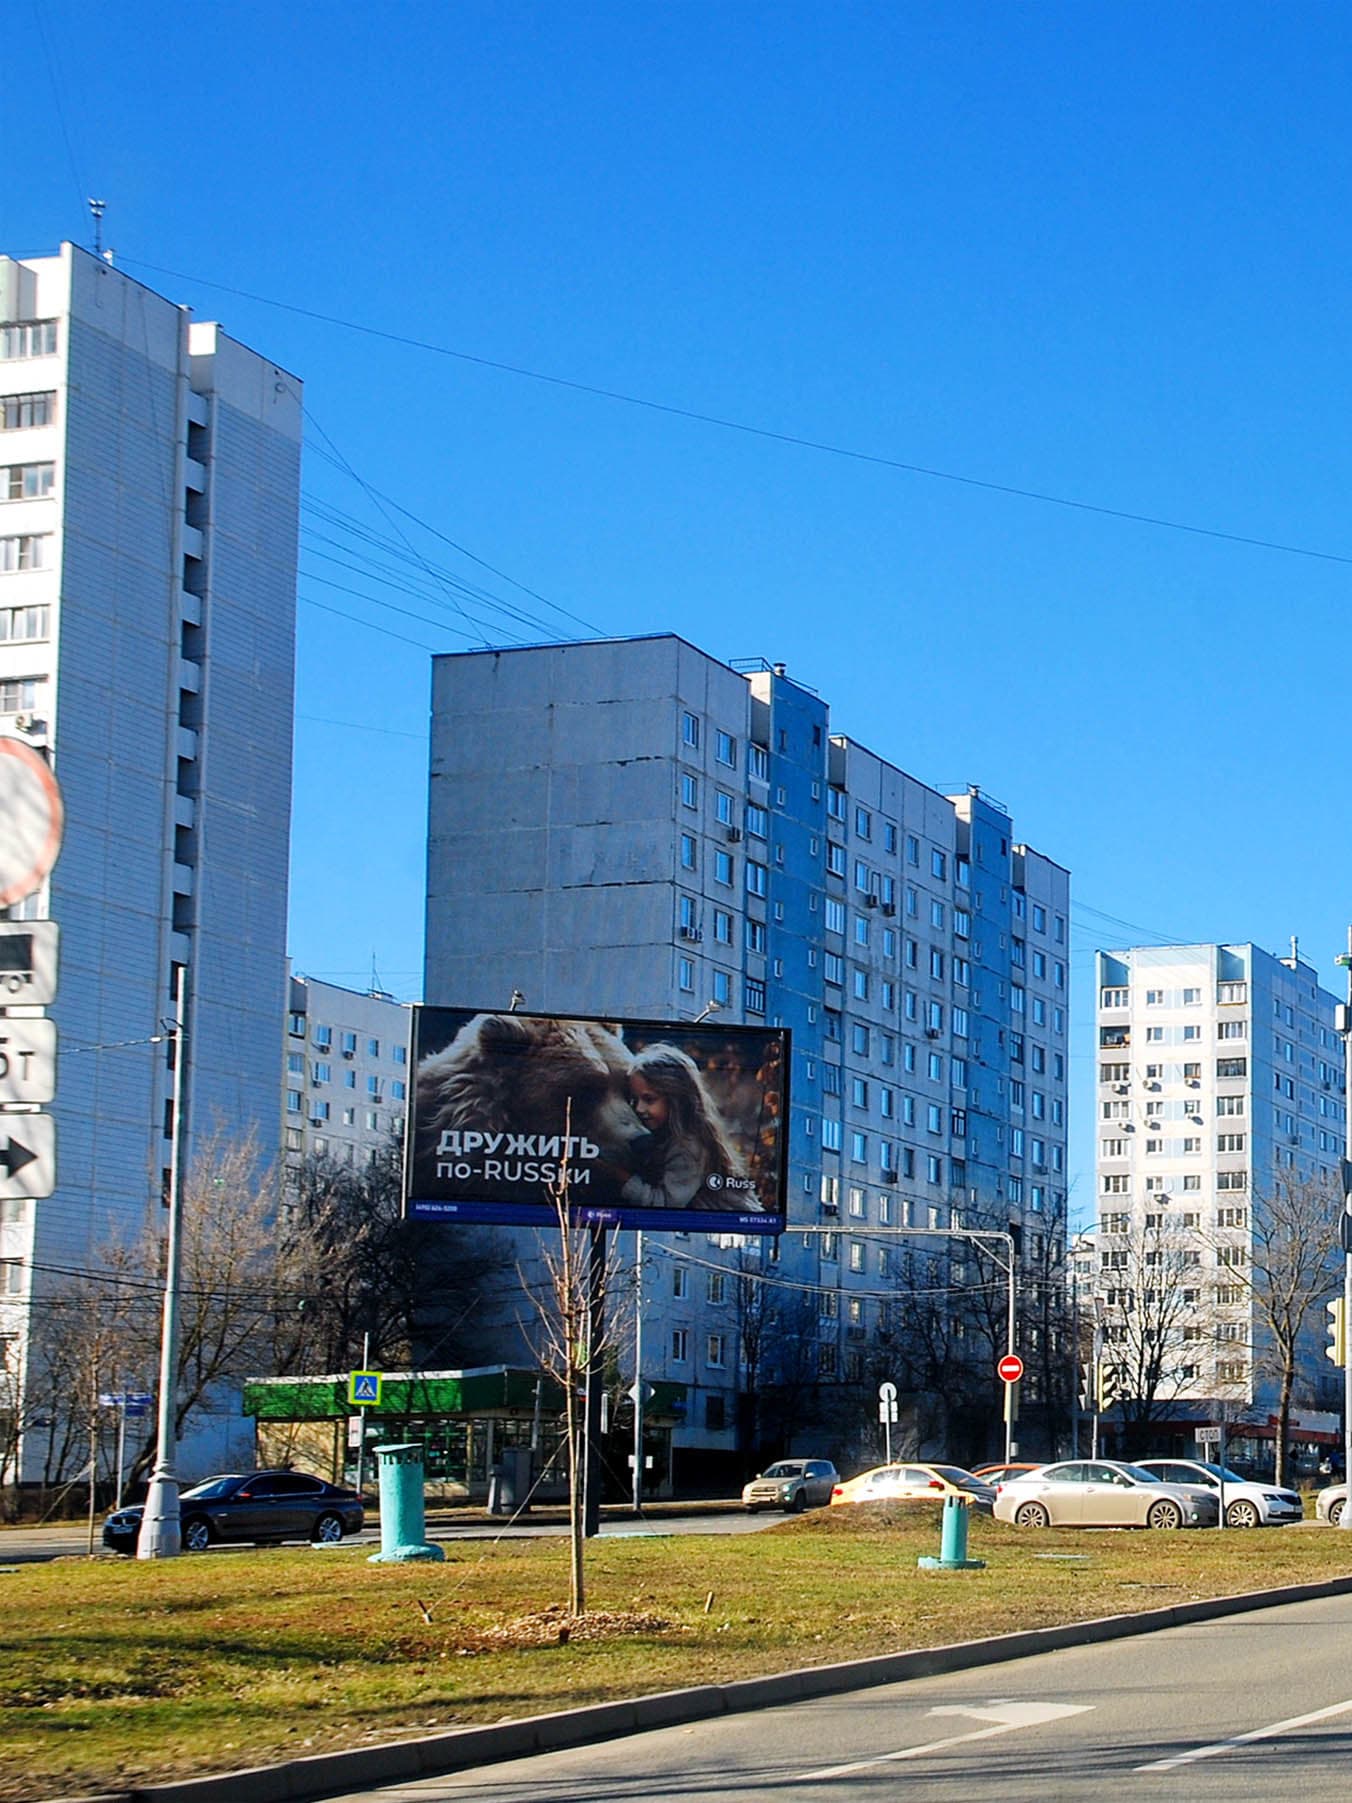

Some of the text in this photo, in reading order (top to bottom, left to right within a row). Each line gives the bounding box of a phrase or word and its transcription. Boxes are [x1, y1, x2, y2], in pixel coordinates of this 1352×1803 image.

[436, 1130, 600, 1159] ДРУЖИТЬ
[436, 1159, 591, 1185] по-RUSSки
[726, 1176, 756, 1190] Russ
